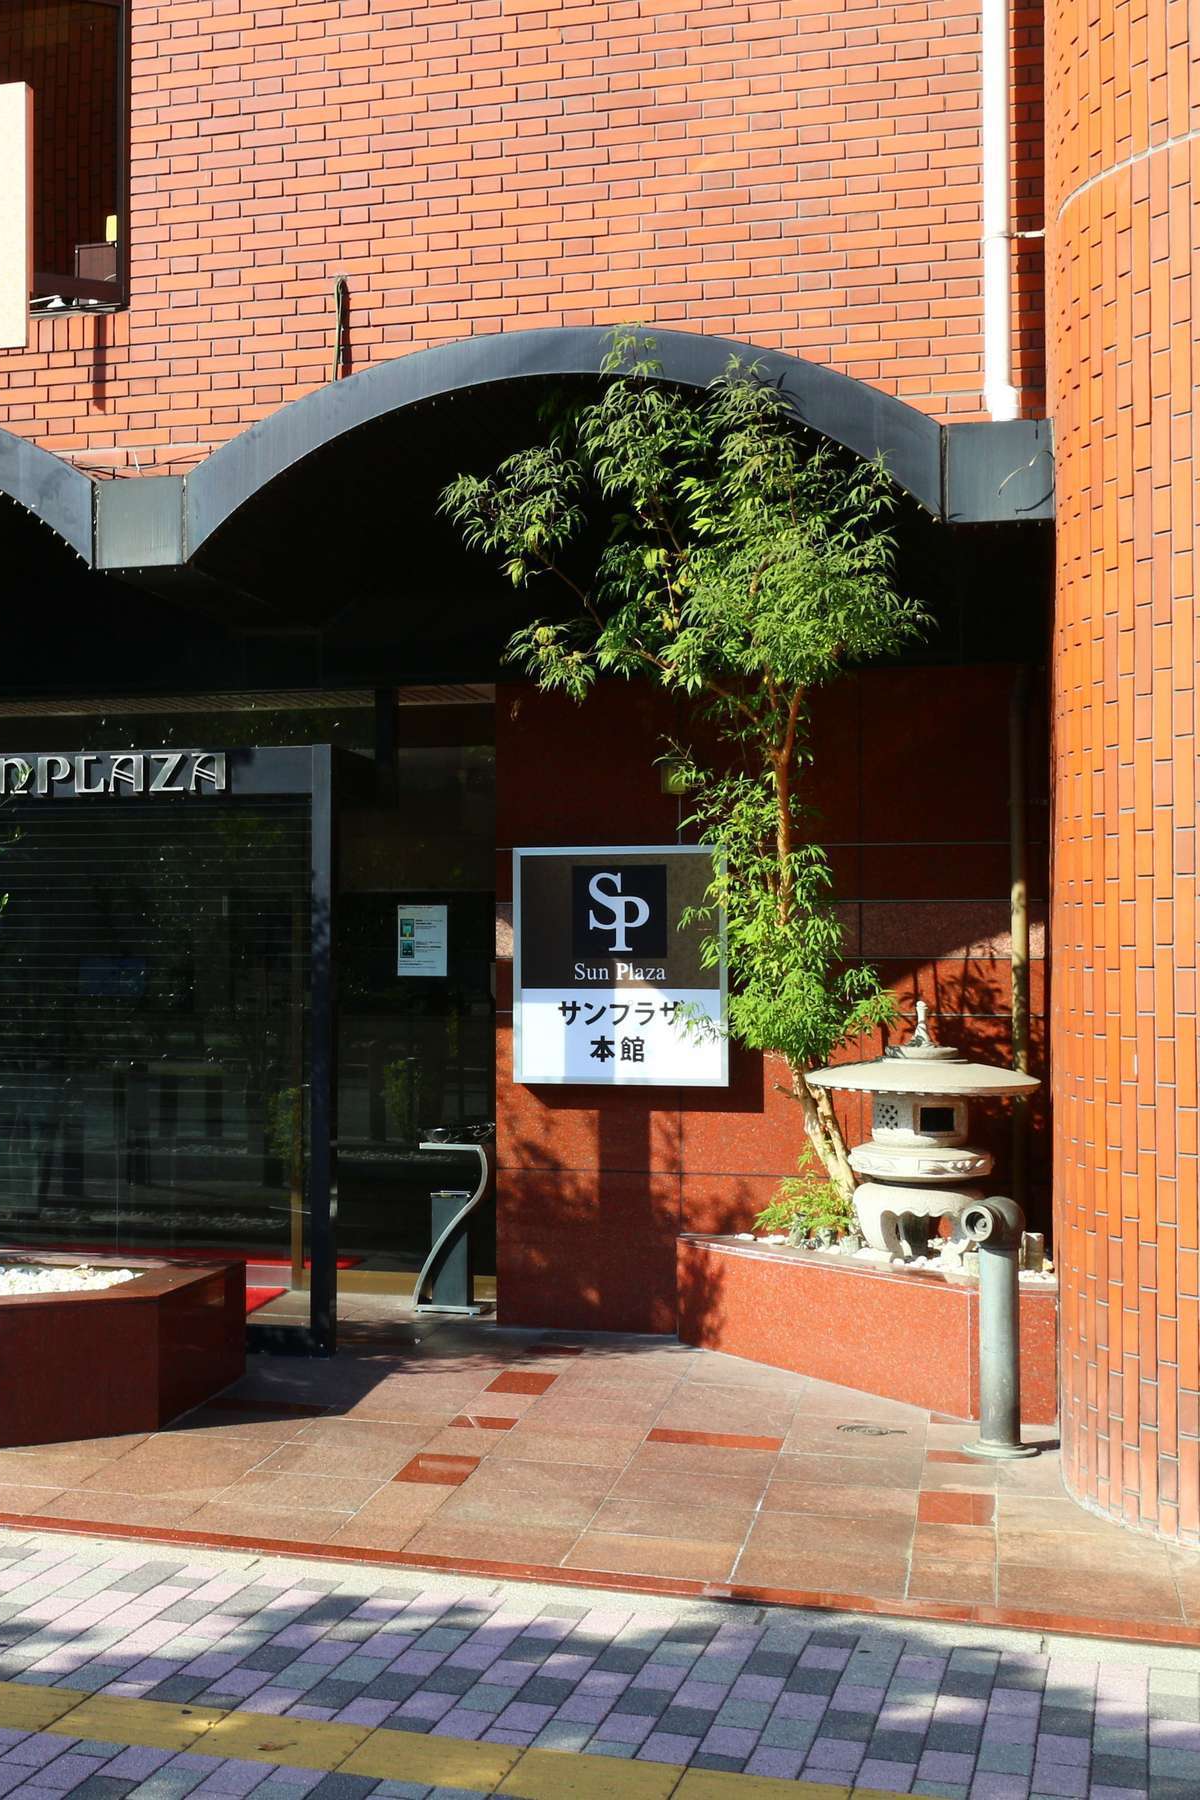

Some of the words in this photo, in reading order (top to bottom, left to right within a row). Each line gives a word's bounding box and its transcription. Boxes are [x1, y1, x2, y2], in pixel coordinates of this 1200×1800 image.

[588, 872, 650, 952] SP
[574, 962, 609, 981] Sun
[615, 962, 667, 981] Plaza
[557, 1000, 686, 1026] サンプラザ
[590, 1035, 645, 1063] 本館
